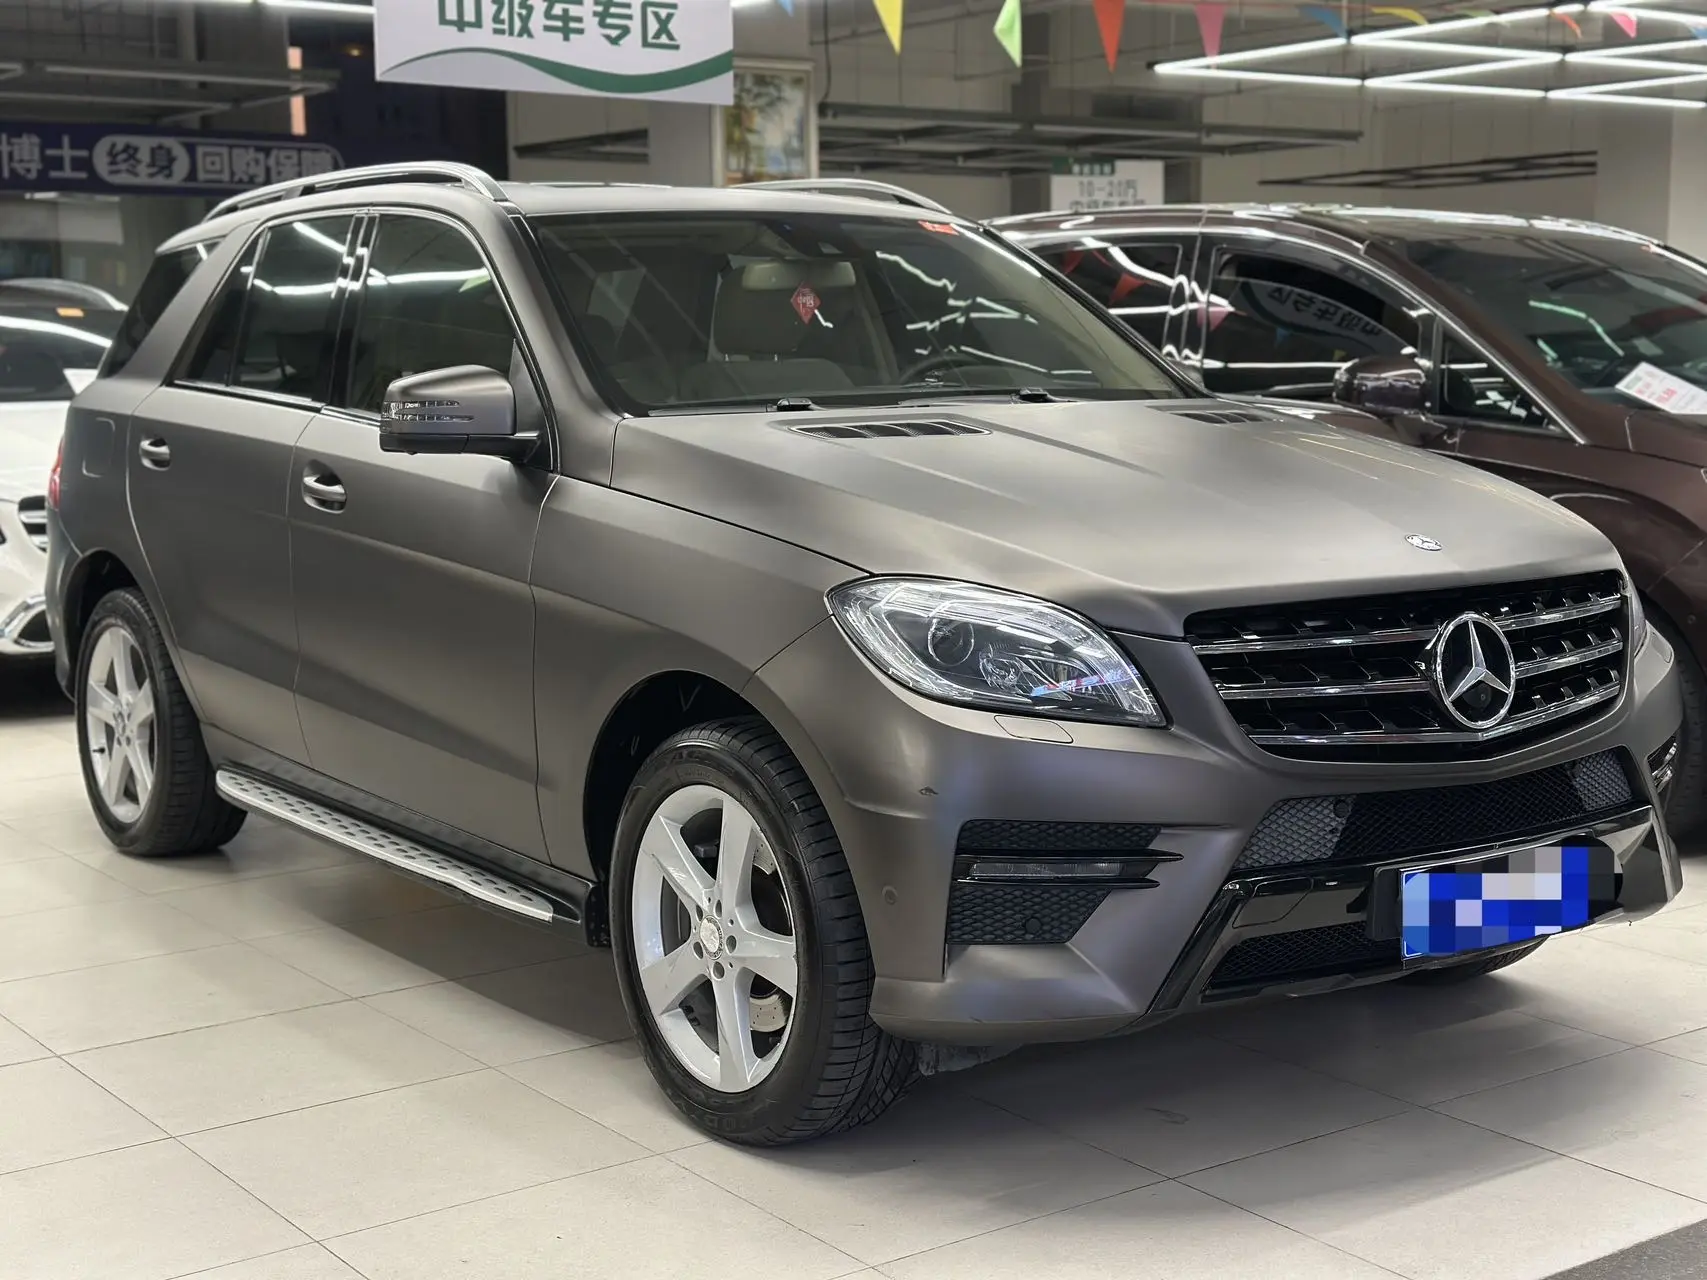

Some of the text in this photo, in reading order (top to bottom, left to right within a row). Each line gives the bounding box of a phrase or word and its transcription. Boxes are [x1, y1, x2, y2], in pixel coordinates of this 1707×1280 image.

[438, 0, 681, 51] 中级车专区
[0, 133, 89, 180] 博士
[106, 141, 178, 179] 终身
